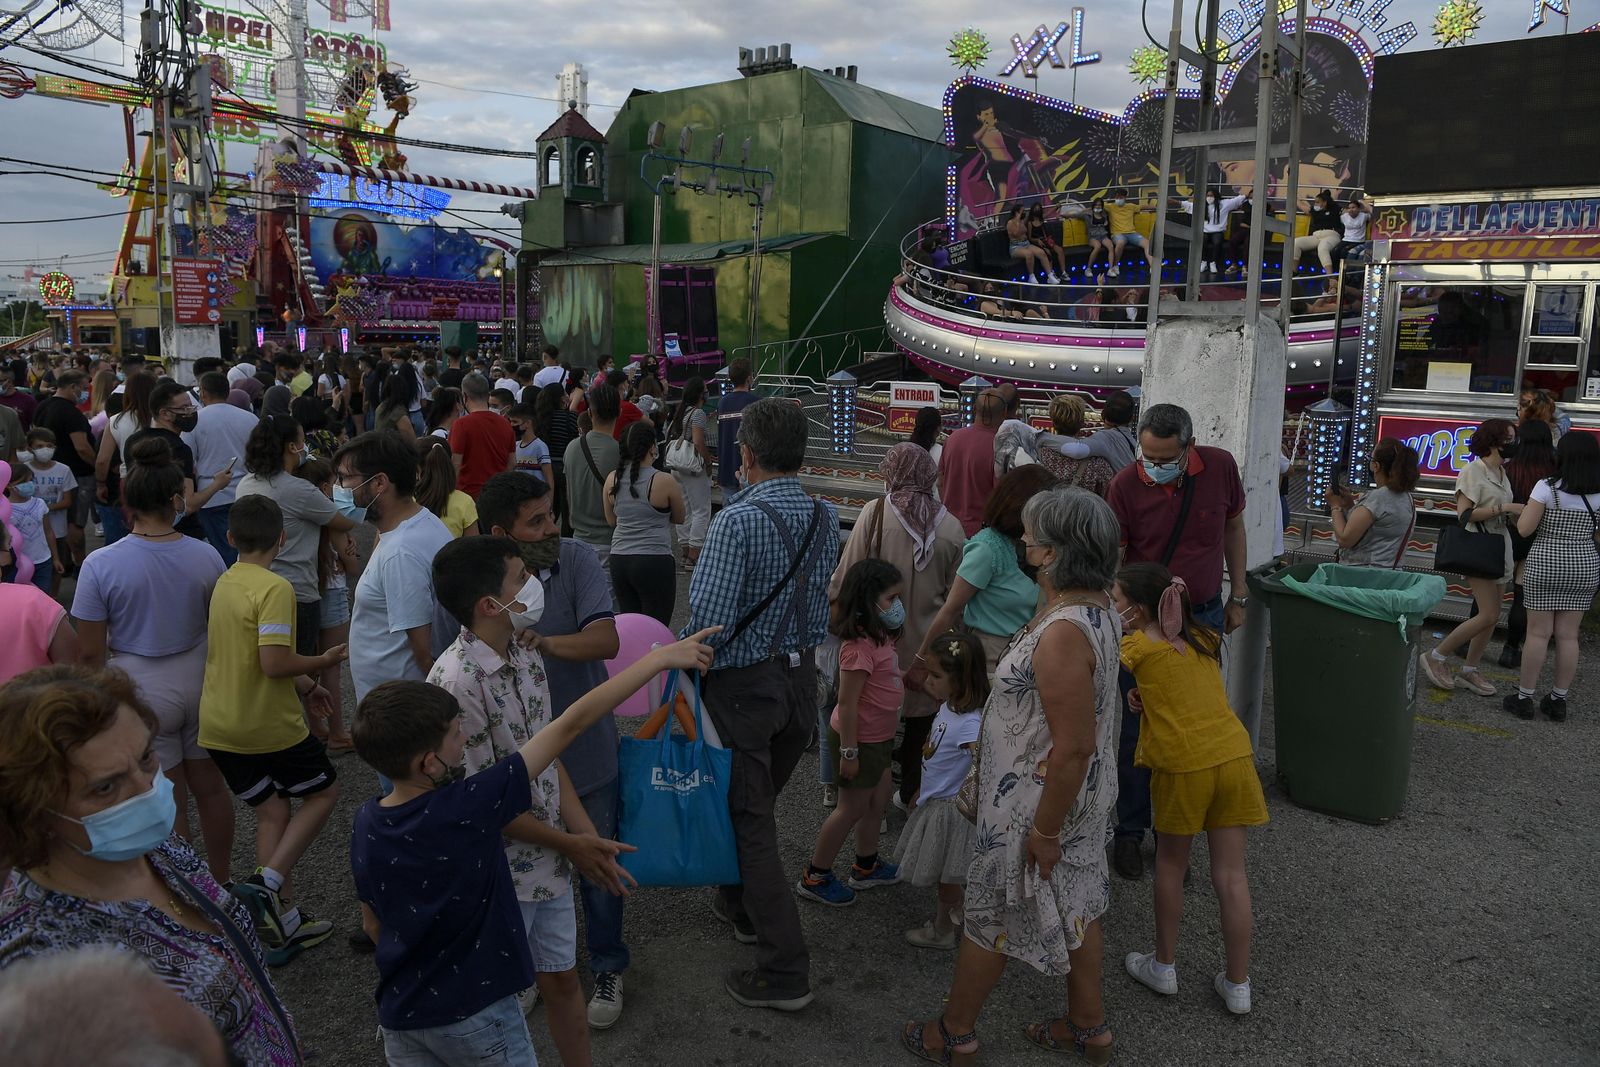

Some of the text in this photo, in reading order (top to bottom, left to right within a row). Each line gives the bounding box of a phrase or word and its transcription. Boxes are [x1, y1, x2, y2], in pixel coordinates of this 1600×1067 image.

[997, 7, 1102, 78] XXL
[356, 176, 424, 214] GUN
[43, 280, 69, 291] FLIP
[48, 286, 68, 298] FLY
[895, 388, 935, 402] ENTRADA
